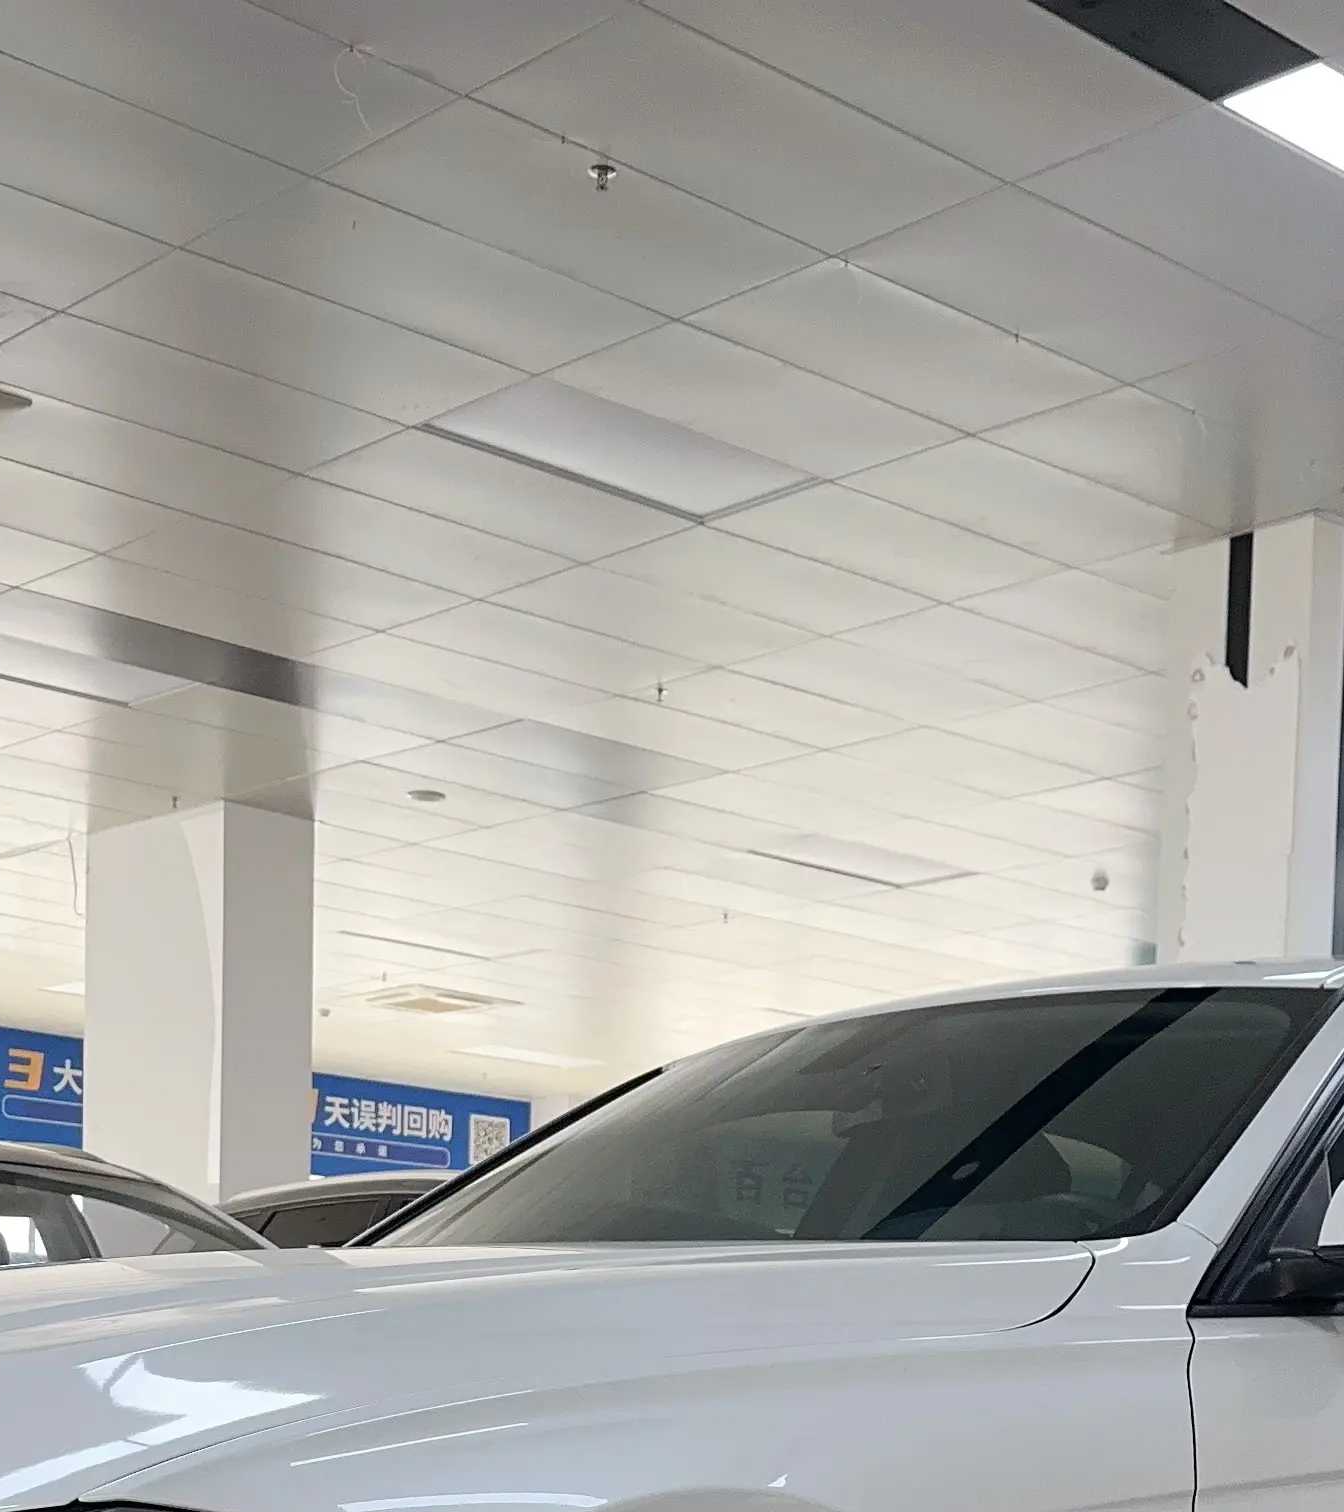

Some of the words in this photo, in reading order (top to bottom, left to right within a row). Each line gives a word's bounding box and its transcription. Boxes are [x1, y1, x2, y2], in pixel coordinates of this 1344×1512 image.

[312, 1088, 453, 1141] 天误判回购
